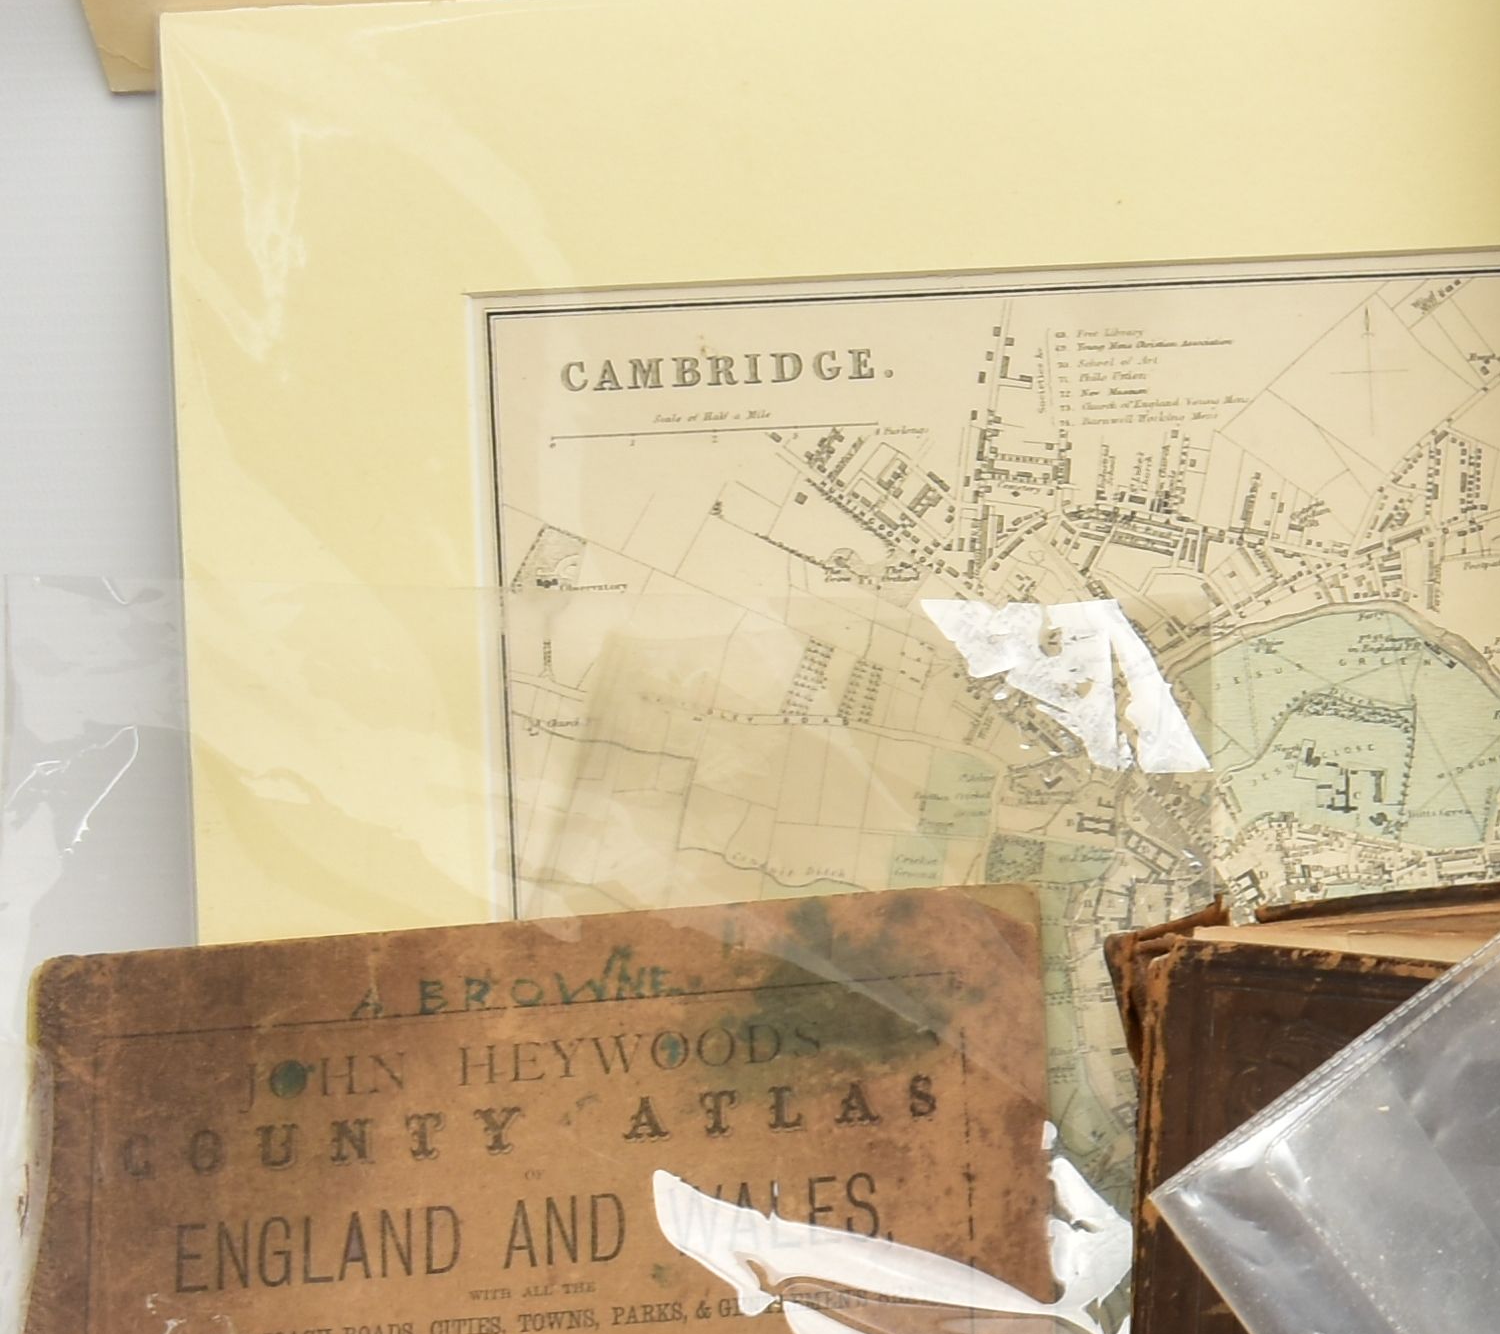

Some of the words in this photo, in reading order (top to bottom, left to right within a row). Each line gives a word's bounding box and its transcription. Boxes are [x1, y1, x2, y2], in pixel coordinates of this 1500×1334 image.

[560, 347, 895, 393] CAMBRIDGE.
[241, 1052, 405, 1113] JOHN
[457, 1025, 822, 1088] HEYWOODS
[121, 1107, 525, 1179] COUNTY
[624, 1074, 939, 1144] ATLAS
[174, 1204, 462, 1294] ENGLAND
[505, 1193, 626, 1268] AND
[469, 1288, 515, 1302] WITH
[524, 1284, 554, 1299] ALL
[562, 1280, 597, 1294] THE
[612, 1302, 688, 1330] PARKS,
